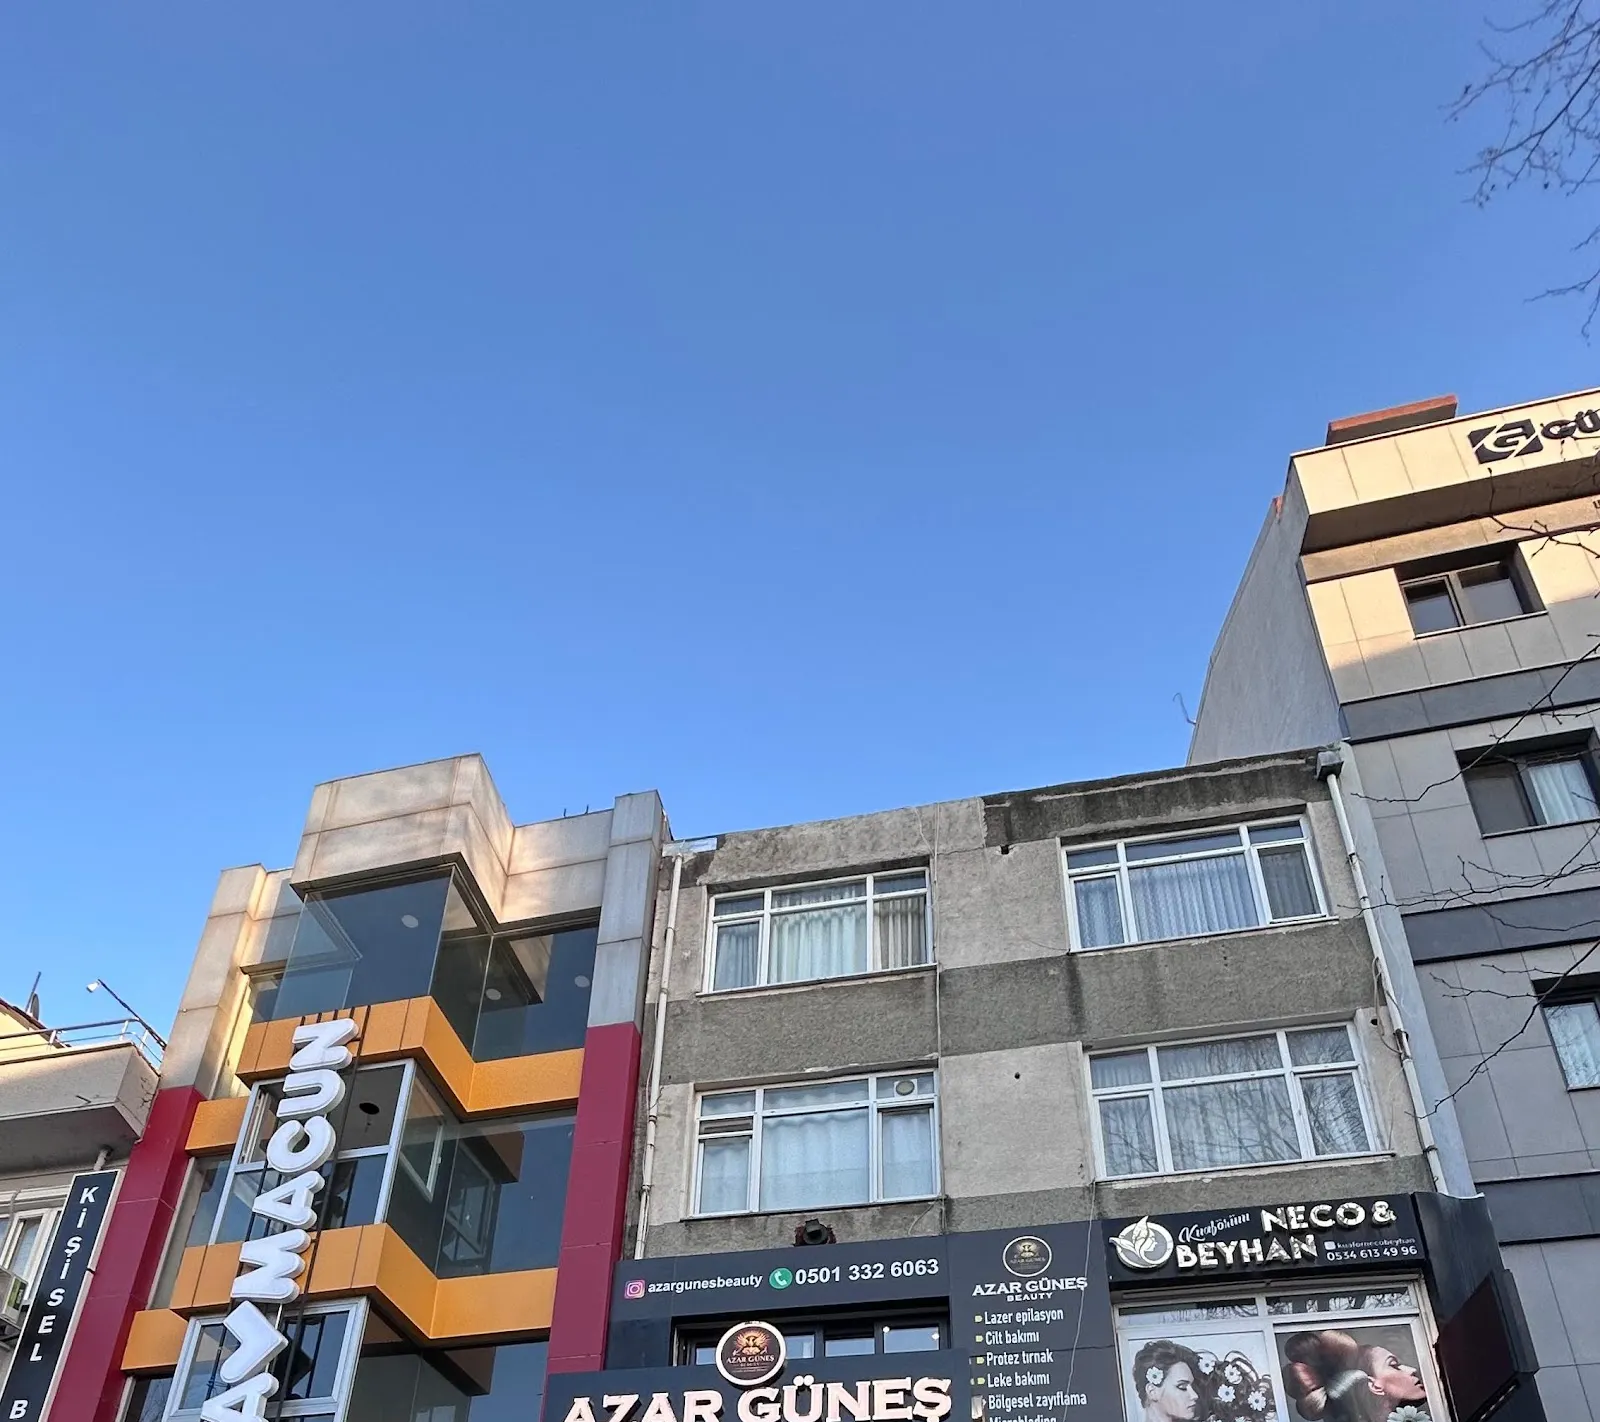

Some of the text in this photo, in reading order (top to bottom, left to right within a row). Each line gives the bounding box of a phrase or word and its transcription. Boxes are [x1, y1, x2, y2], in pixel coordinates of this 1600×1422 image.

[1178, 1212, 1251, 1243] Kuaförüm
[1260, 1200, 1397, 1235] NECO &
[1176, 1234, 1318, 1269] BEYHAN
[1326, 1245, 1418, 1261] 0534 613 49 96
[30, 1186, 99, 1362] KİŞİSEL
[795, 1258, 940, 1285] 0501 332 6063
[648, 1273, 763, 1294] azargunesbeauty
[972, 1277, 1088, 1296] AZAR GÜNEŞ
[1007, 1292, 1053, 1302] BEAUTY
[984, 1308, 1064, 1325] Lazer epilasyon
[985, 1329, 1039, 1345] Cilt bakımı
[986, 1349, 1054, 1366] Protez tırnak
[987, 1371, 1050, 1387] Leke bakımı
[988, 1391, 1087, 1412] Bölgesel zayıflama
